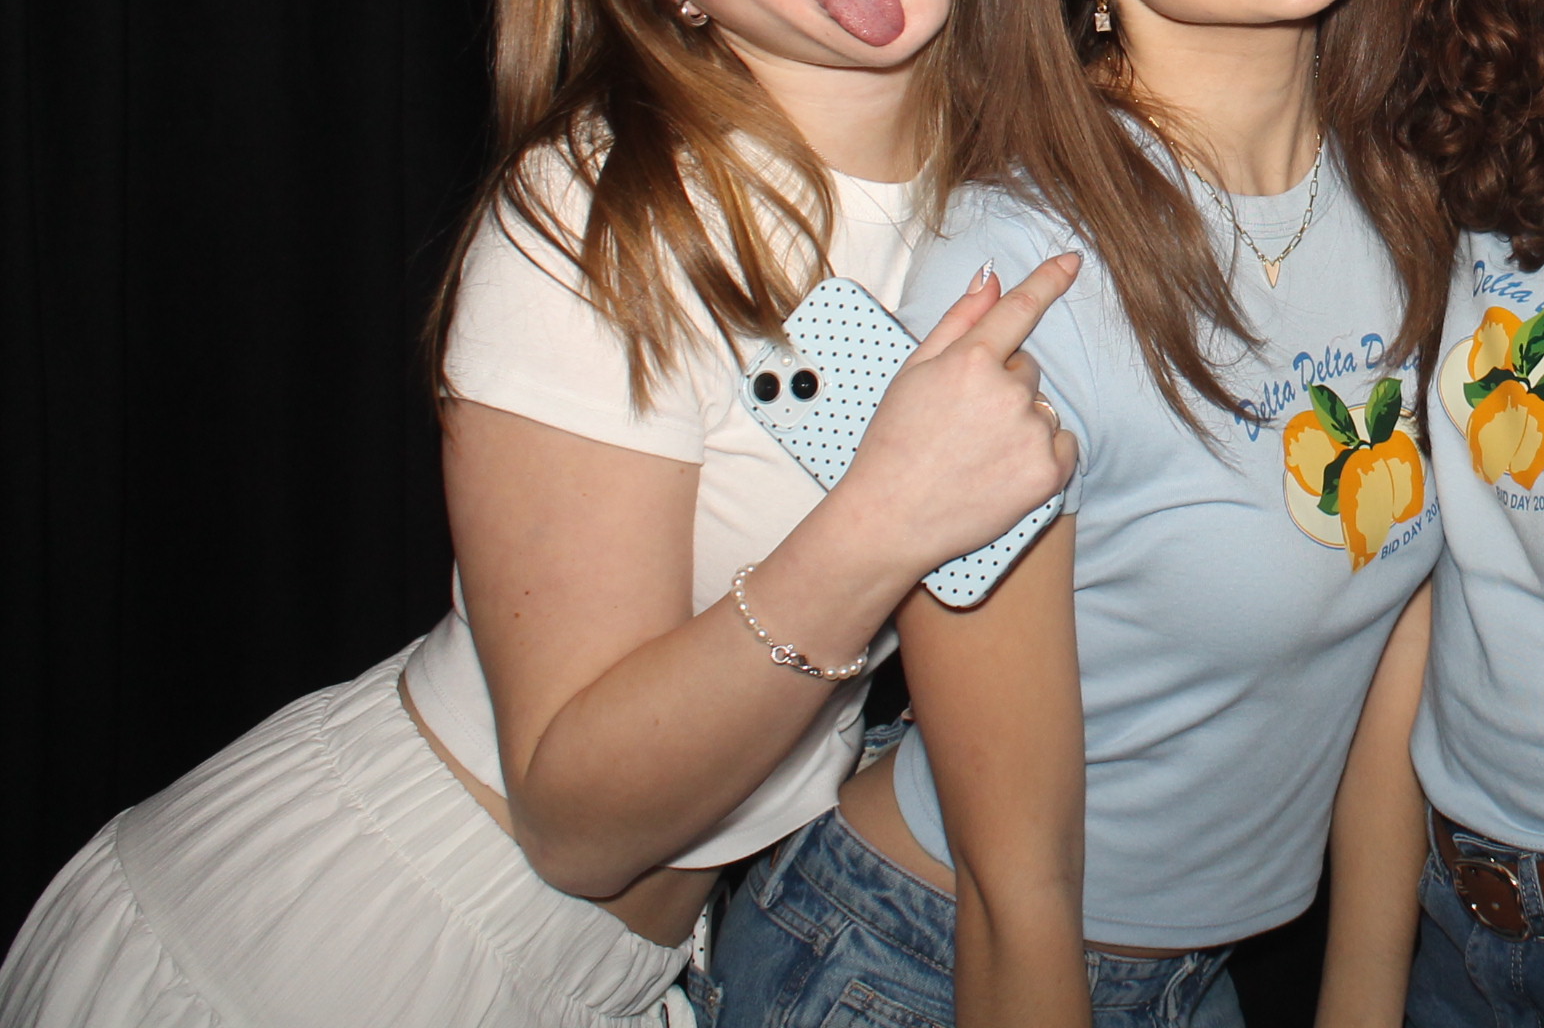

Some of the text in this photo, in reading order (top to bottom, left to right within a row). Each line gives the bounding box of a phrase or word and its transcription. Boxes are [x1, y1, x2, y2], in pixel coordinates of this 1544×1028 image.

[1473, 260, 1533, 303] Delta
[1234, 380, 1296, 442] Delta
[1293, 345, 1358, 390] Delta
[1380, 496, 1441, 560] BID DAY 20
[1510, 494, 1531, 511] DAY
